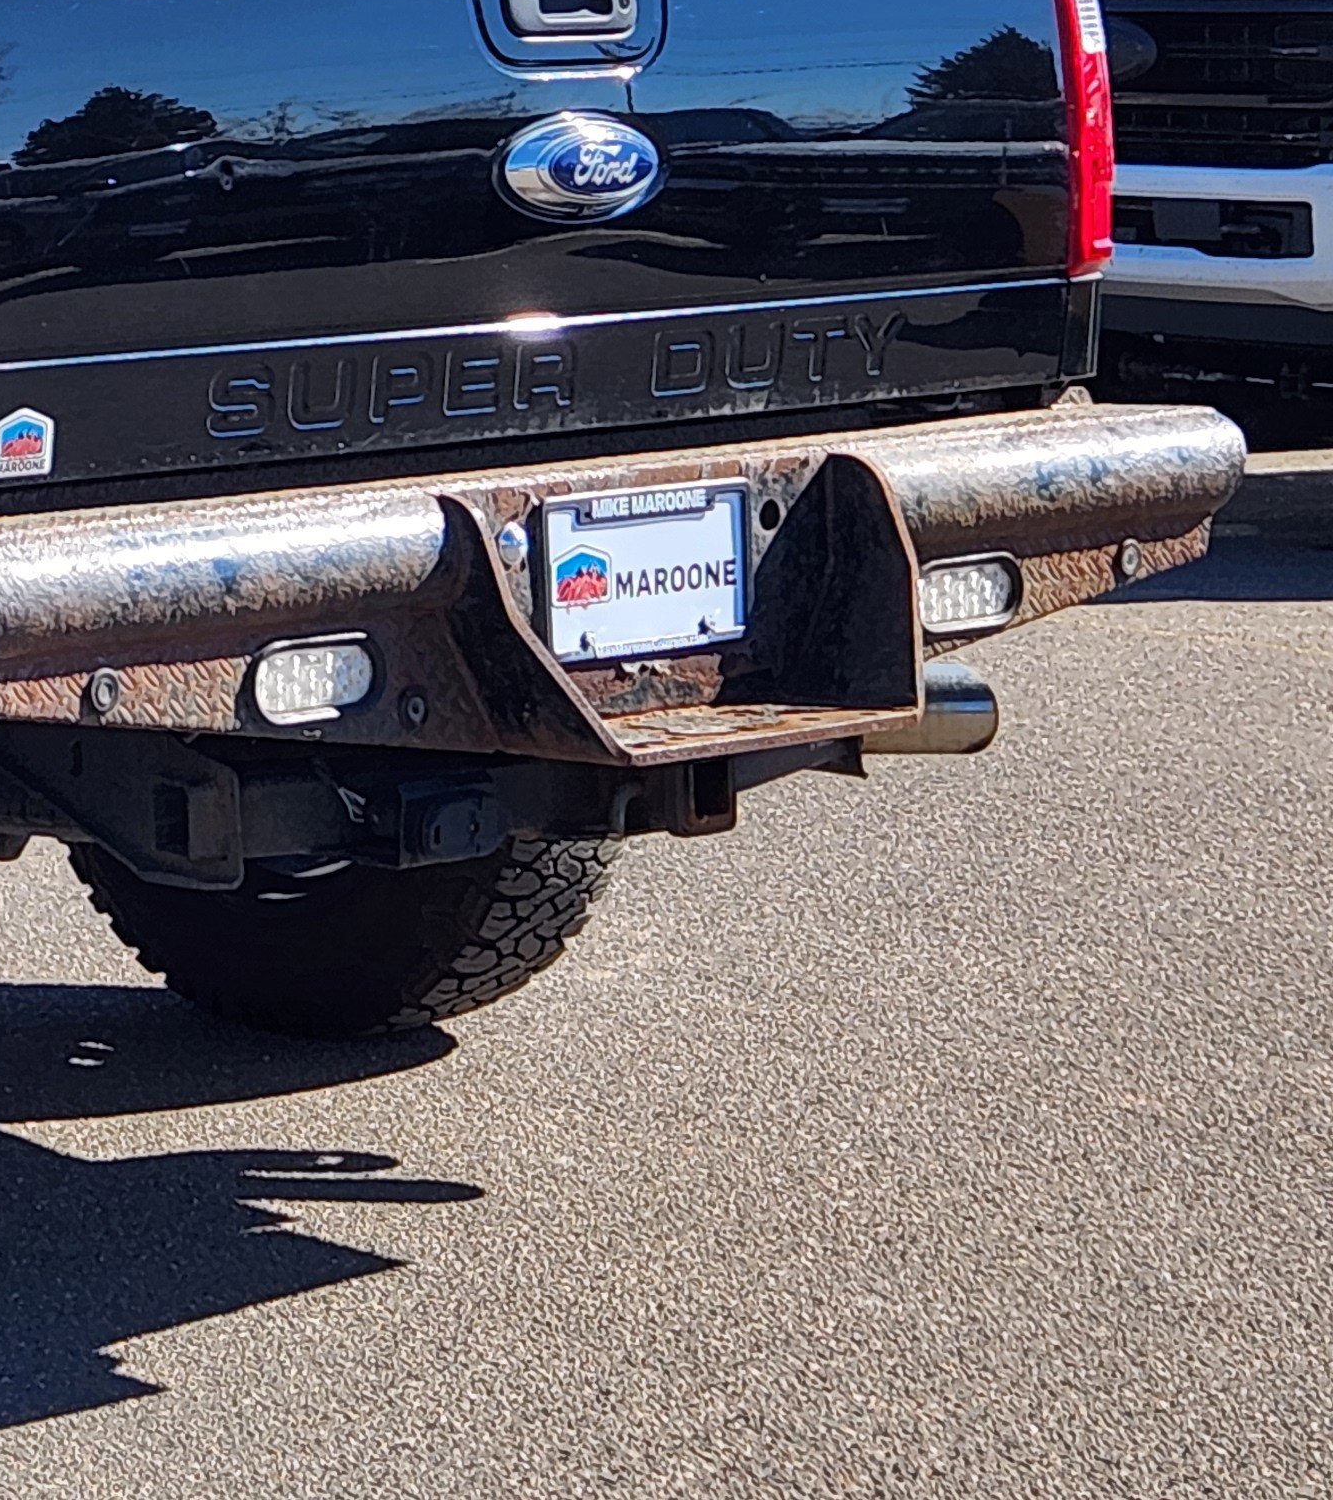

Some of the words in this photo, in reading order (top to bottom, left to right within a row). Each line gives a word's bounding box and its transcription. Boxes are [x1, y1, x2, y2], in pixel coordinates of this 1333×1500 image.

[573, 142, 639, 187] Ford
[206, 340, 576, 437] SUPER
[651, 313, 904, 398] DUTY
[591, 497, 630, 519] MIKE
[632, 488, 708, 515] MAROONE
[615, 557, 738, 600] MAROONE
